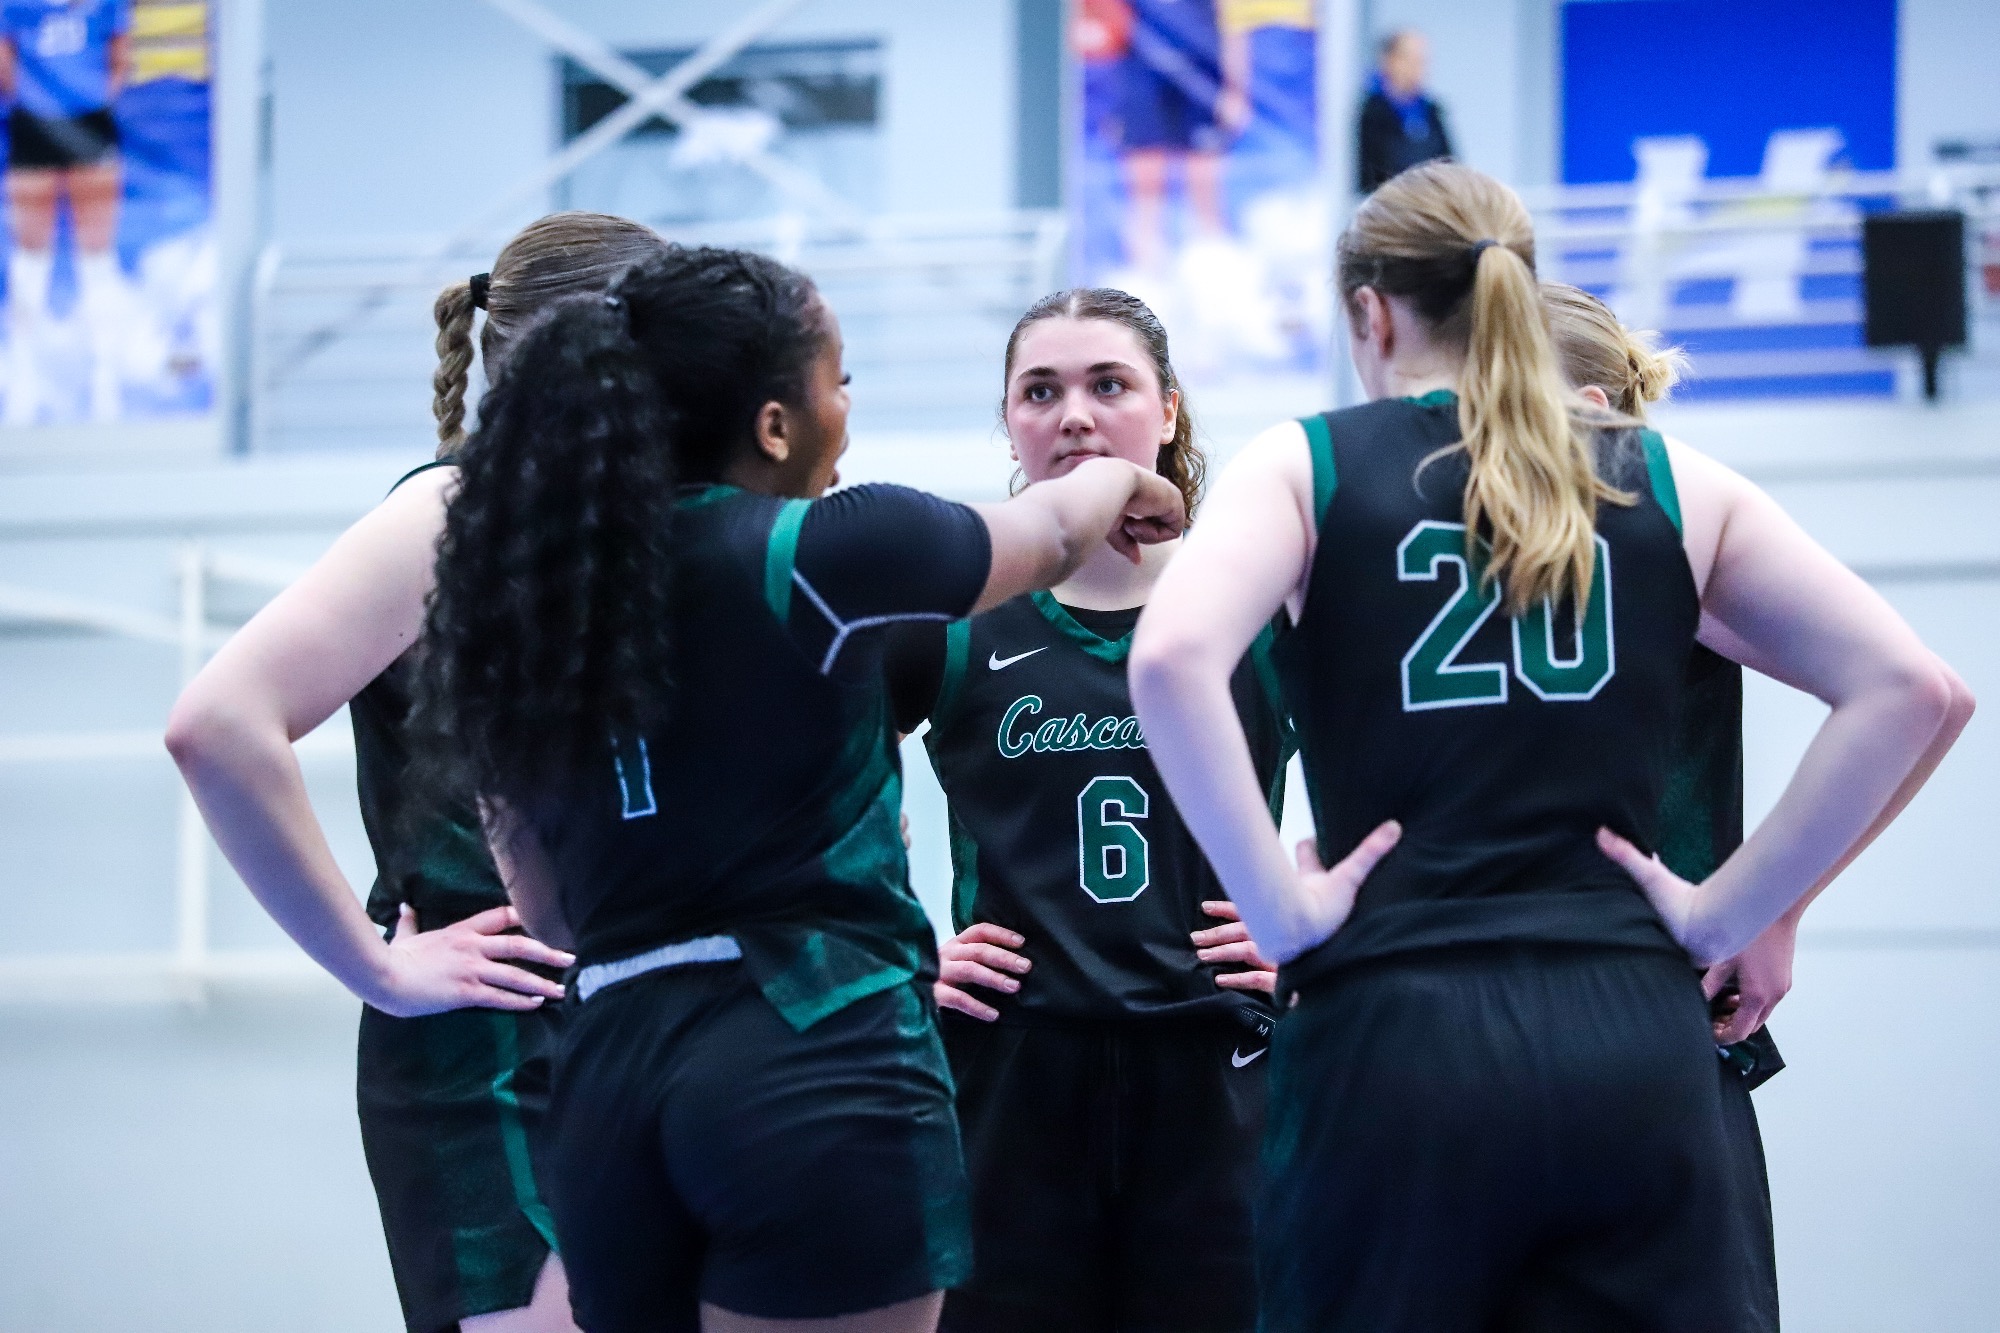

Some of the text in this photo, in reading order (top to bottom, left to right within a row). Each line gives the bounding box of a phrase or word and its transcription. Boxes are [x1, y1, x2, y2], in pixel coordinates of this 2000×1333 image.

[1397, 519, 1615, 712] 20
[997, 694, 1149, 758] Casca
[1077, 775, 1149, 903] 6
[1257, 1023, 1269, 1036] M
